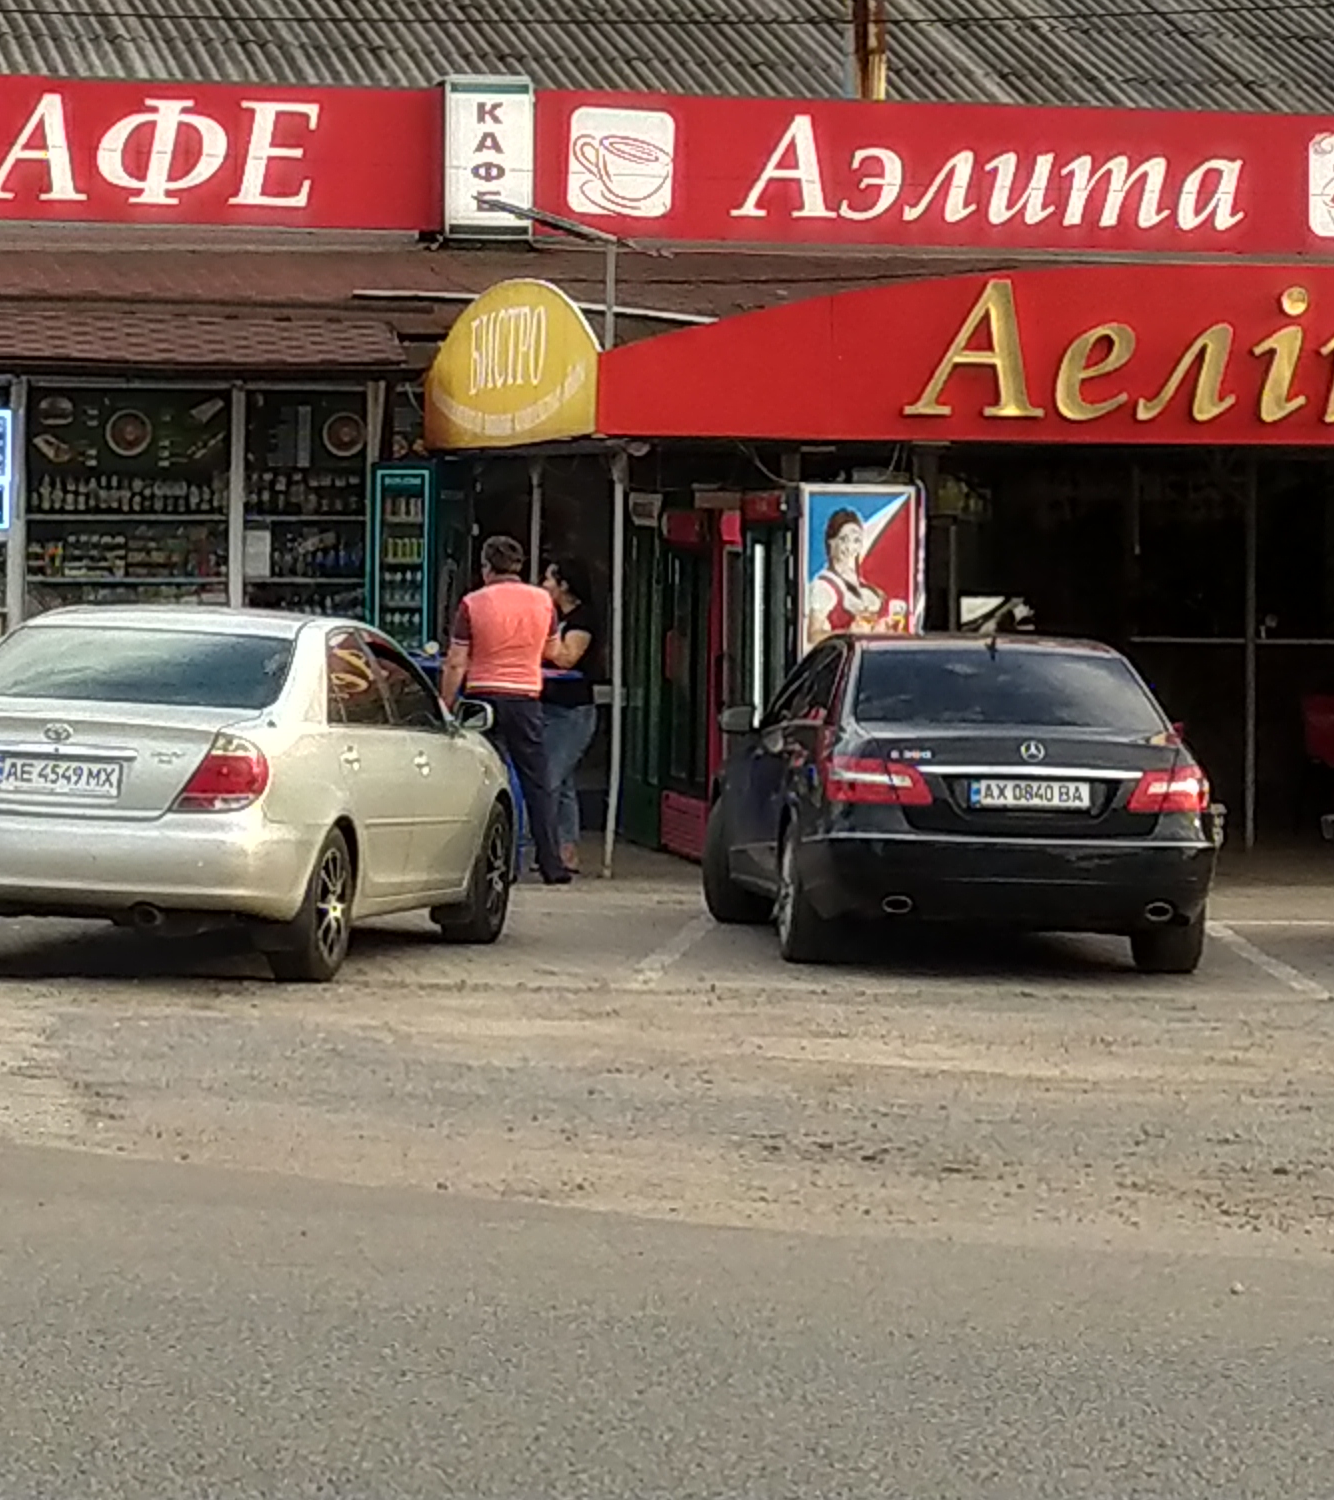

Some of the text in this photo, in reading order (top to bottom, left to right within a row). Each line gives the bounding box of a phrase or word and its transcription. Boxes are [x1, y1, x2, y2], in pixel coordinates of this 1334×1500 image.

[471, 102, 505, 212] КАФЕ
[730, 114, 1244, 231] Аэлита
[38, 764, 84, 785] 4549
[983, 783, 1008, 800] AX
